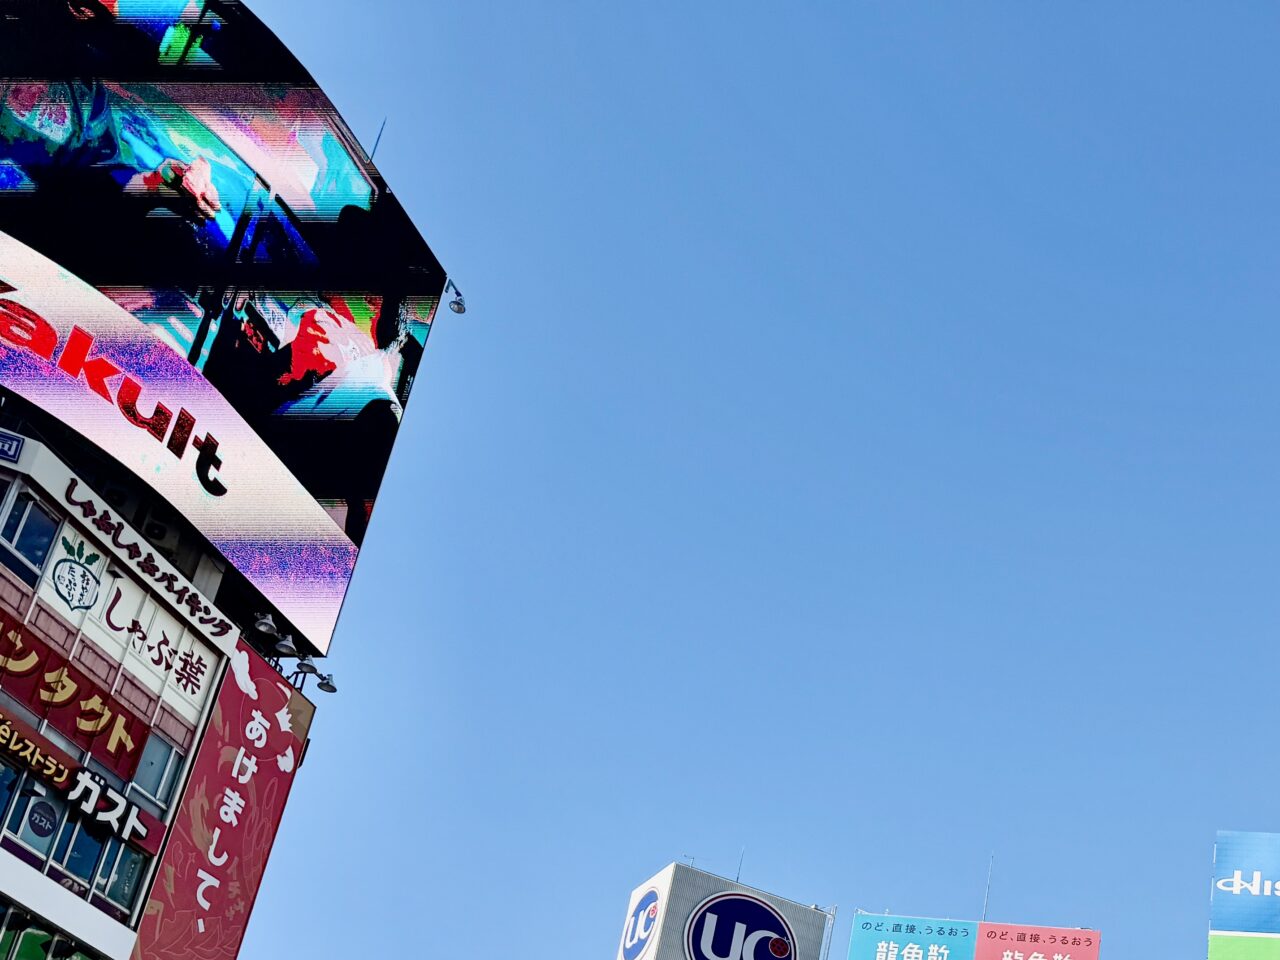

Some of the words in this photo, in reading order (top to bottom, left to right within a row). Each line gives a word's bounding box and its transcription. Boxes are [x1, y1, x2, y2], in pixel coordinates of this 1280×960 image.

[0, 281, 227, 497] akult
[105, 587, 208, 695] しゃぶ葉
[0, 623, 134, 753] ンタクト
[0, 712, 69, 783] éレストラン
[67, 769, 149, 841] ガスト
[196, 708, 271, 934] あけまして、
[624, 901, 658, 949] UC
[861, 921, 970, 937] のど、直接、うるおう
[987, 930, 1094, 947] のど、直接、うるおう
